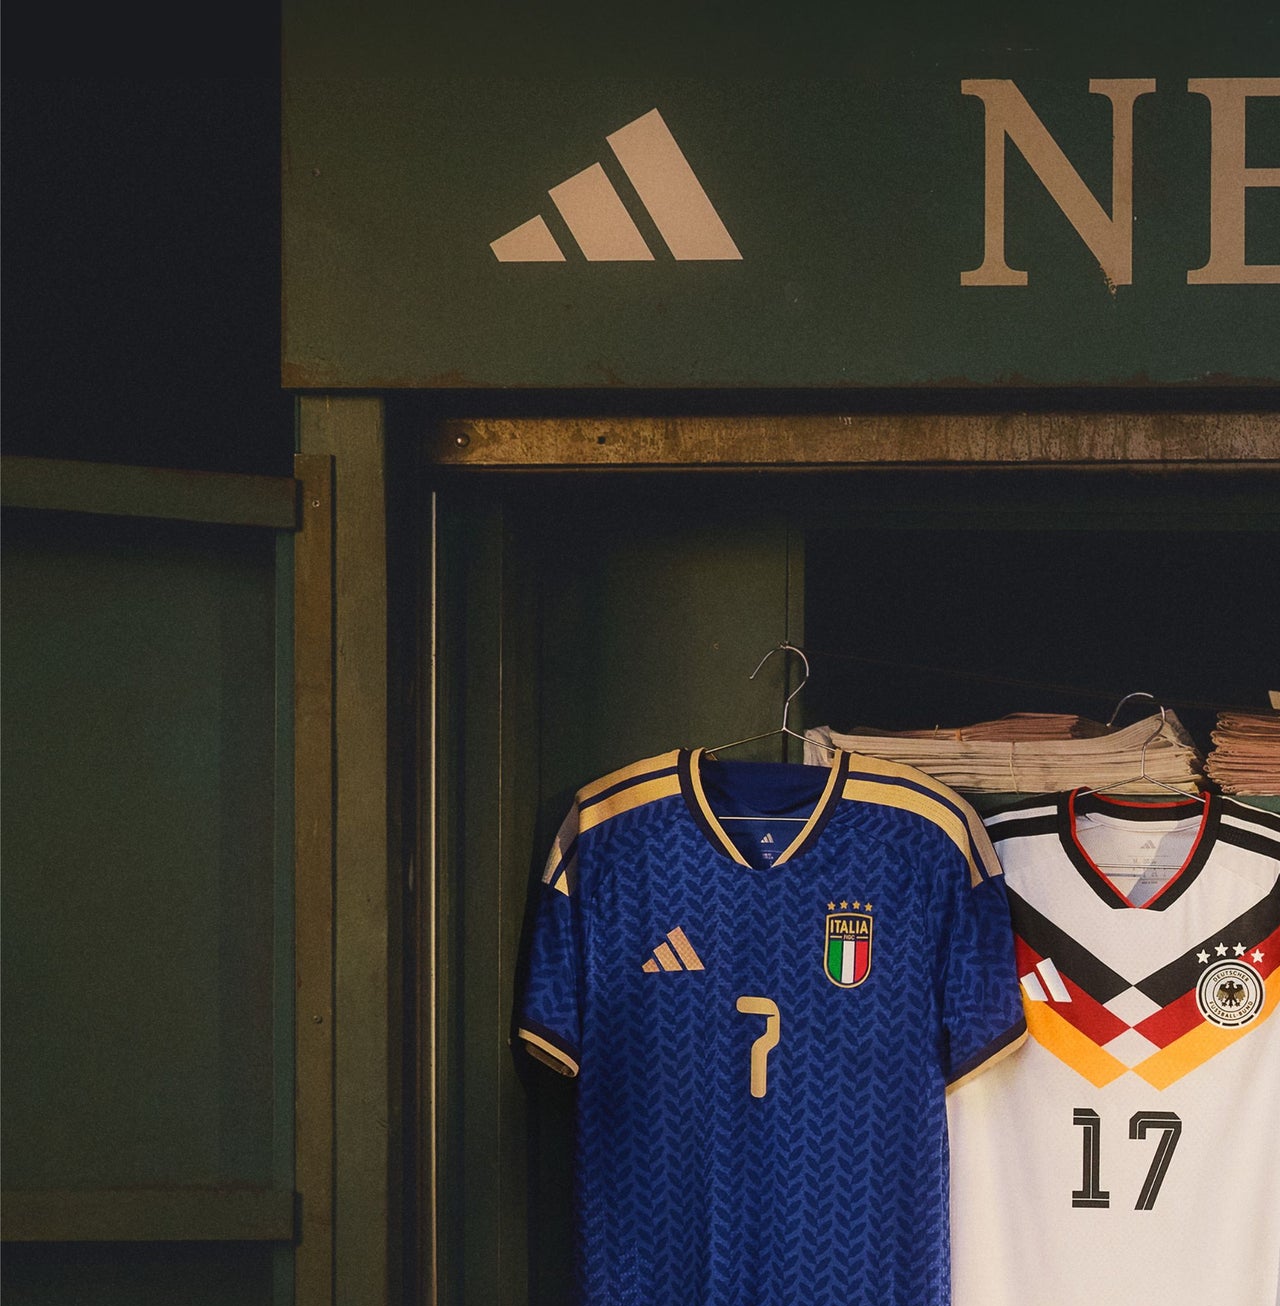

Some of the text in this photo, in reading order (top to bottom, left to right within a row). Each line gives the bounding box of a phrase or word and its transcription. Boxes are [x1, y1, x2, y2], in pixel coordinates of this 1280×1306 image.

[830, 919, 868, 934] ITALIA
[1212, 970, 1250, 982] DEUTSCHER
[736, 996, 780, 1098] 7
[1072, 1107, 1182, 1211] 17
